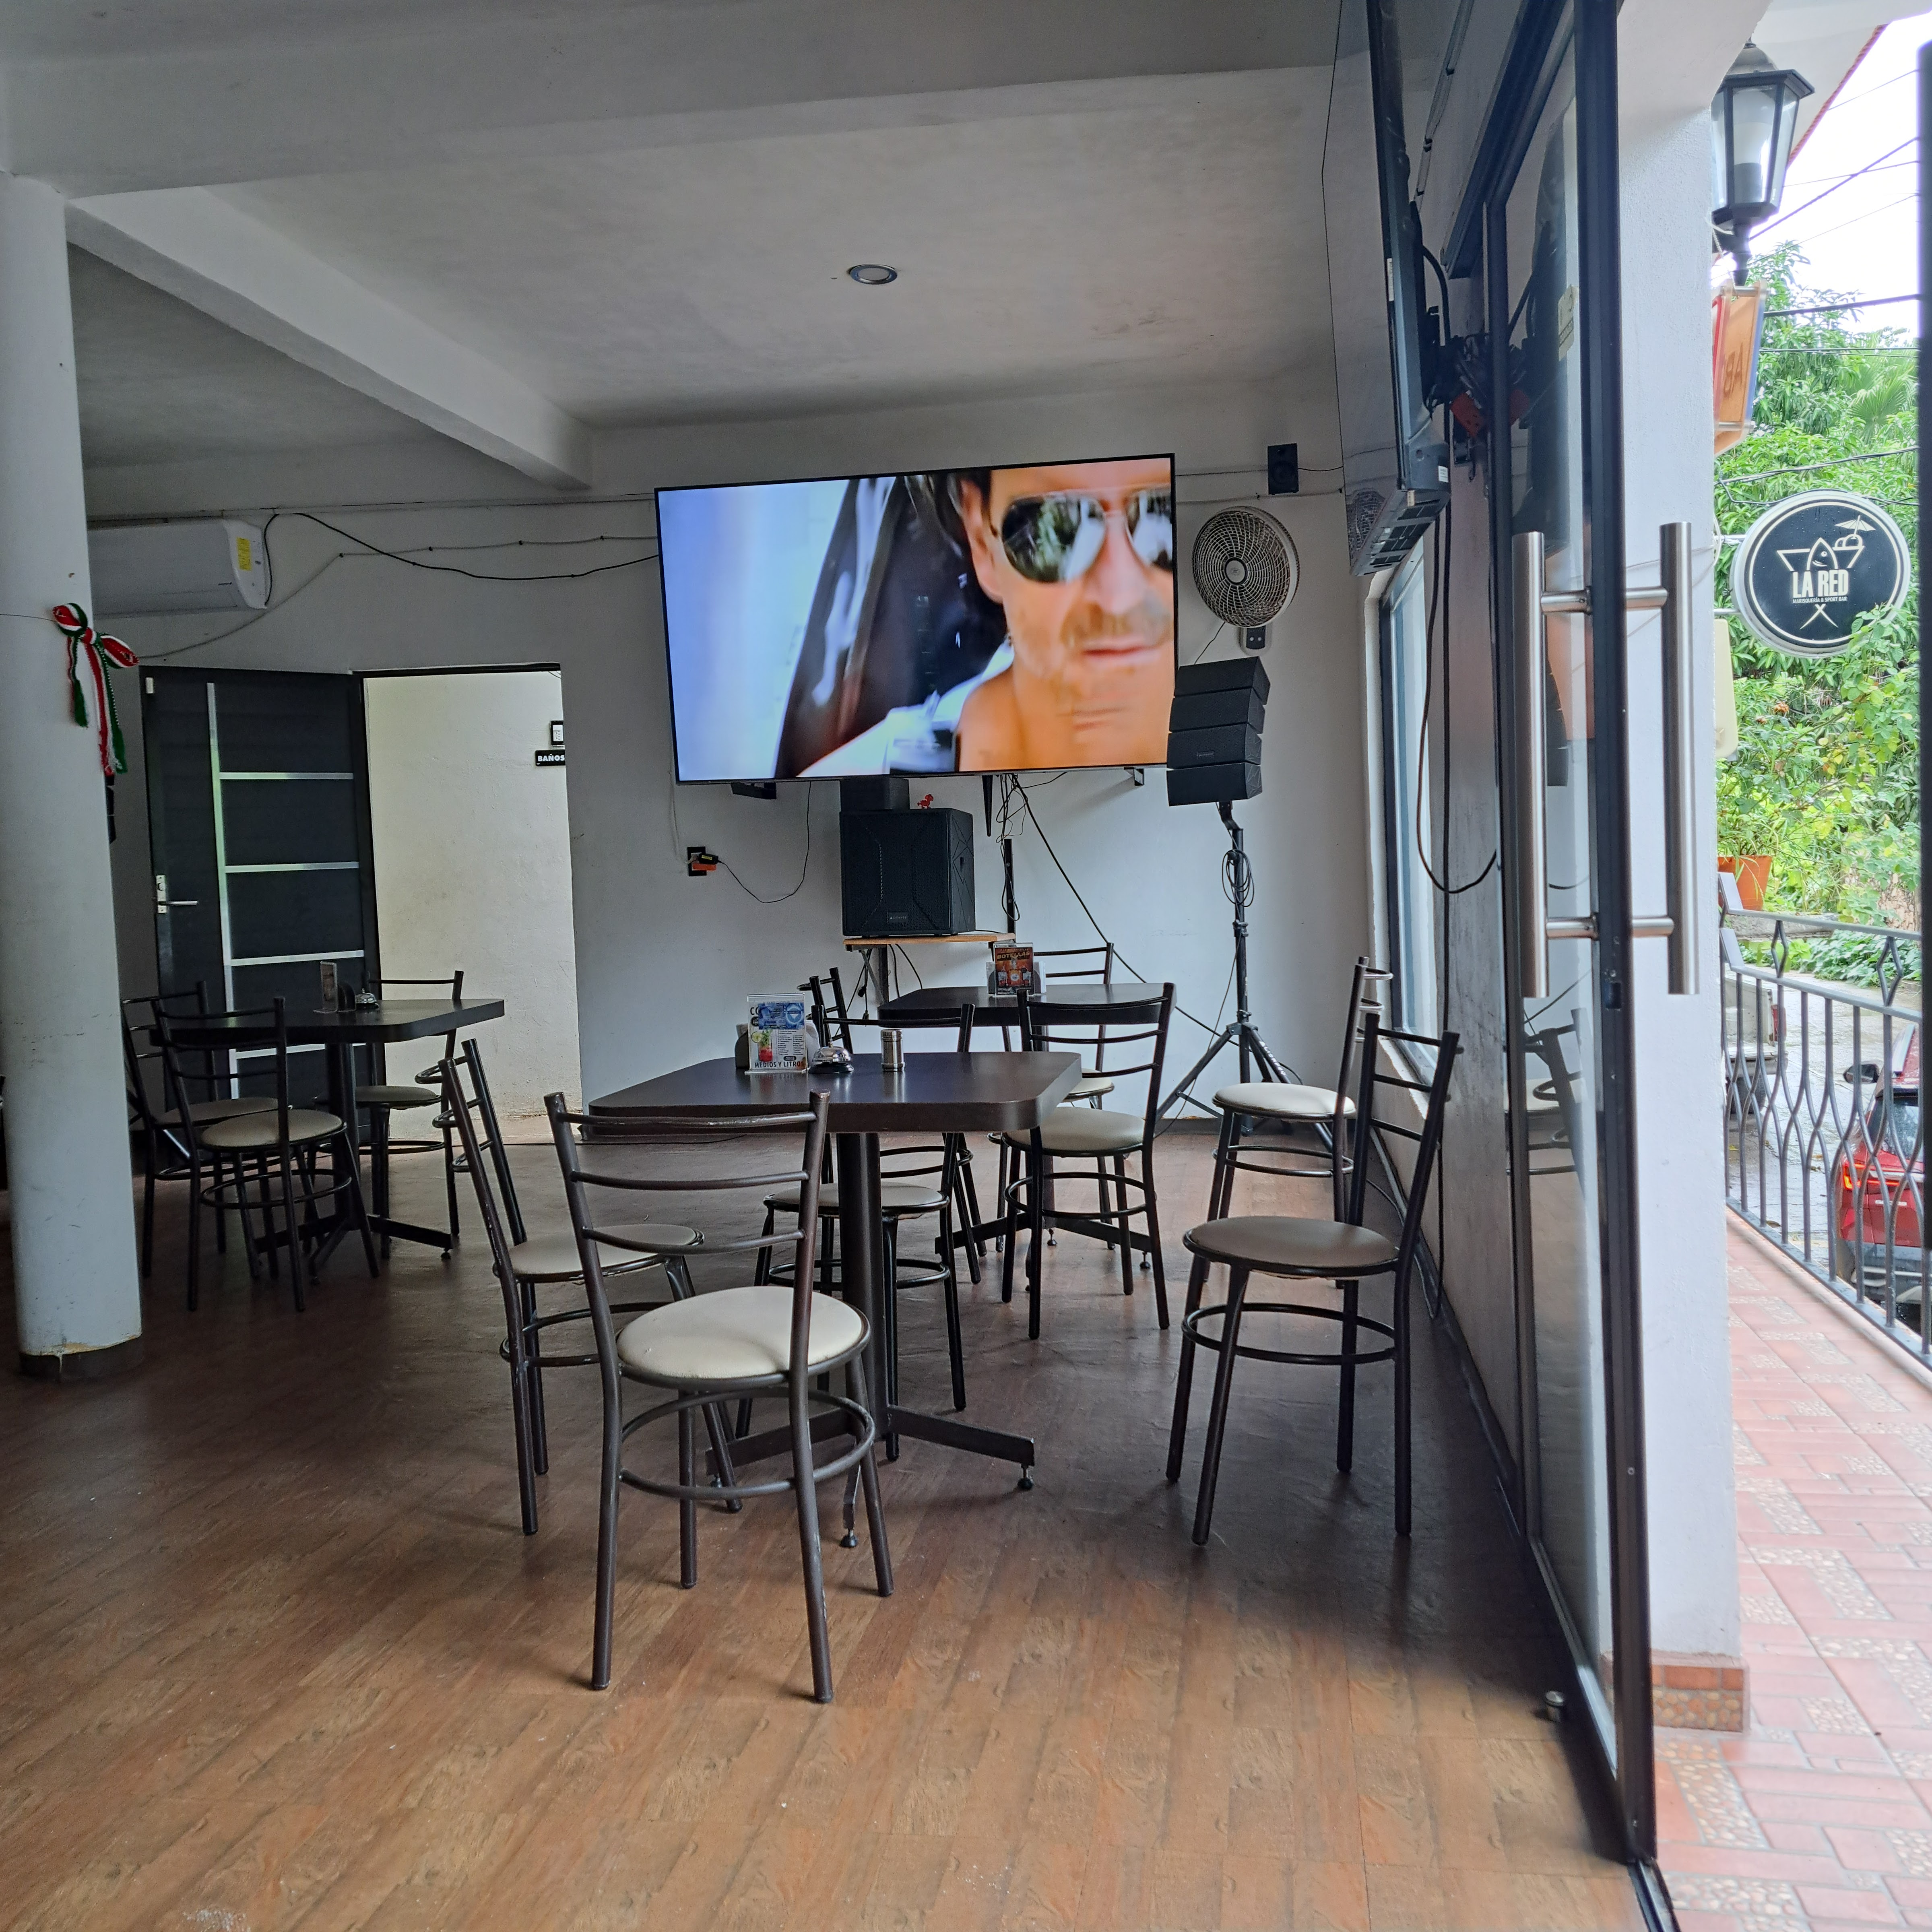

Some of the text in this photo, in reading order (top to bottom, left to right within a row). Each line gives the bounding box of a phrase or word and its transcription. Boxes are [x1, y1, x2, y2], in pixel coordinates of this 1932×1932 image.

[1793, 569, 1848, 598] LA RED
[538, 753, 565, 762] BAÑOS
[997, 951, 1030, 959] BOTELLAS
